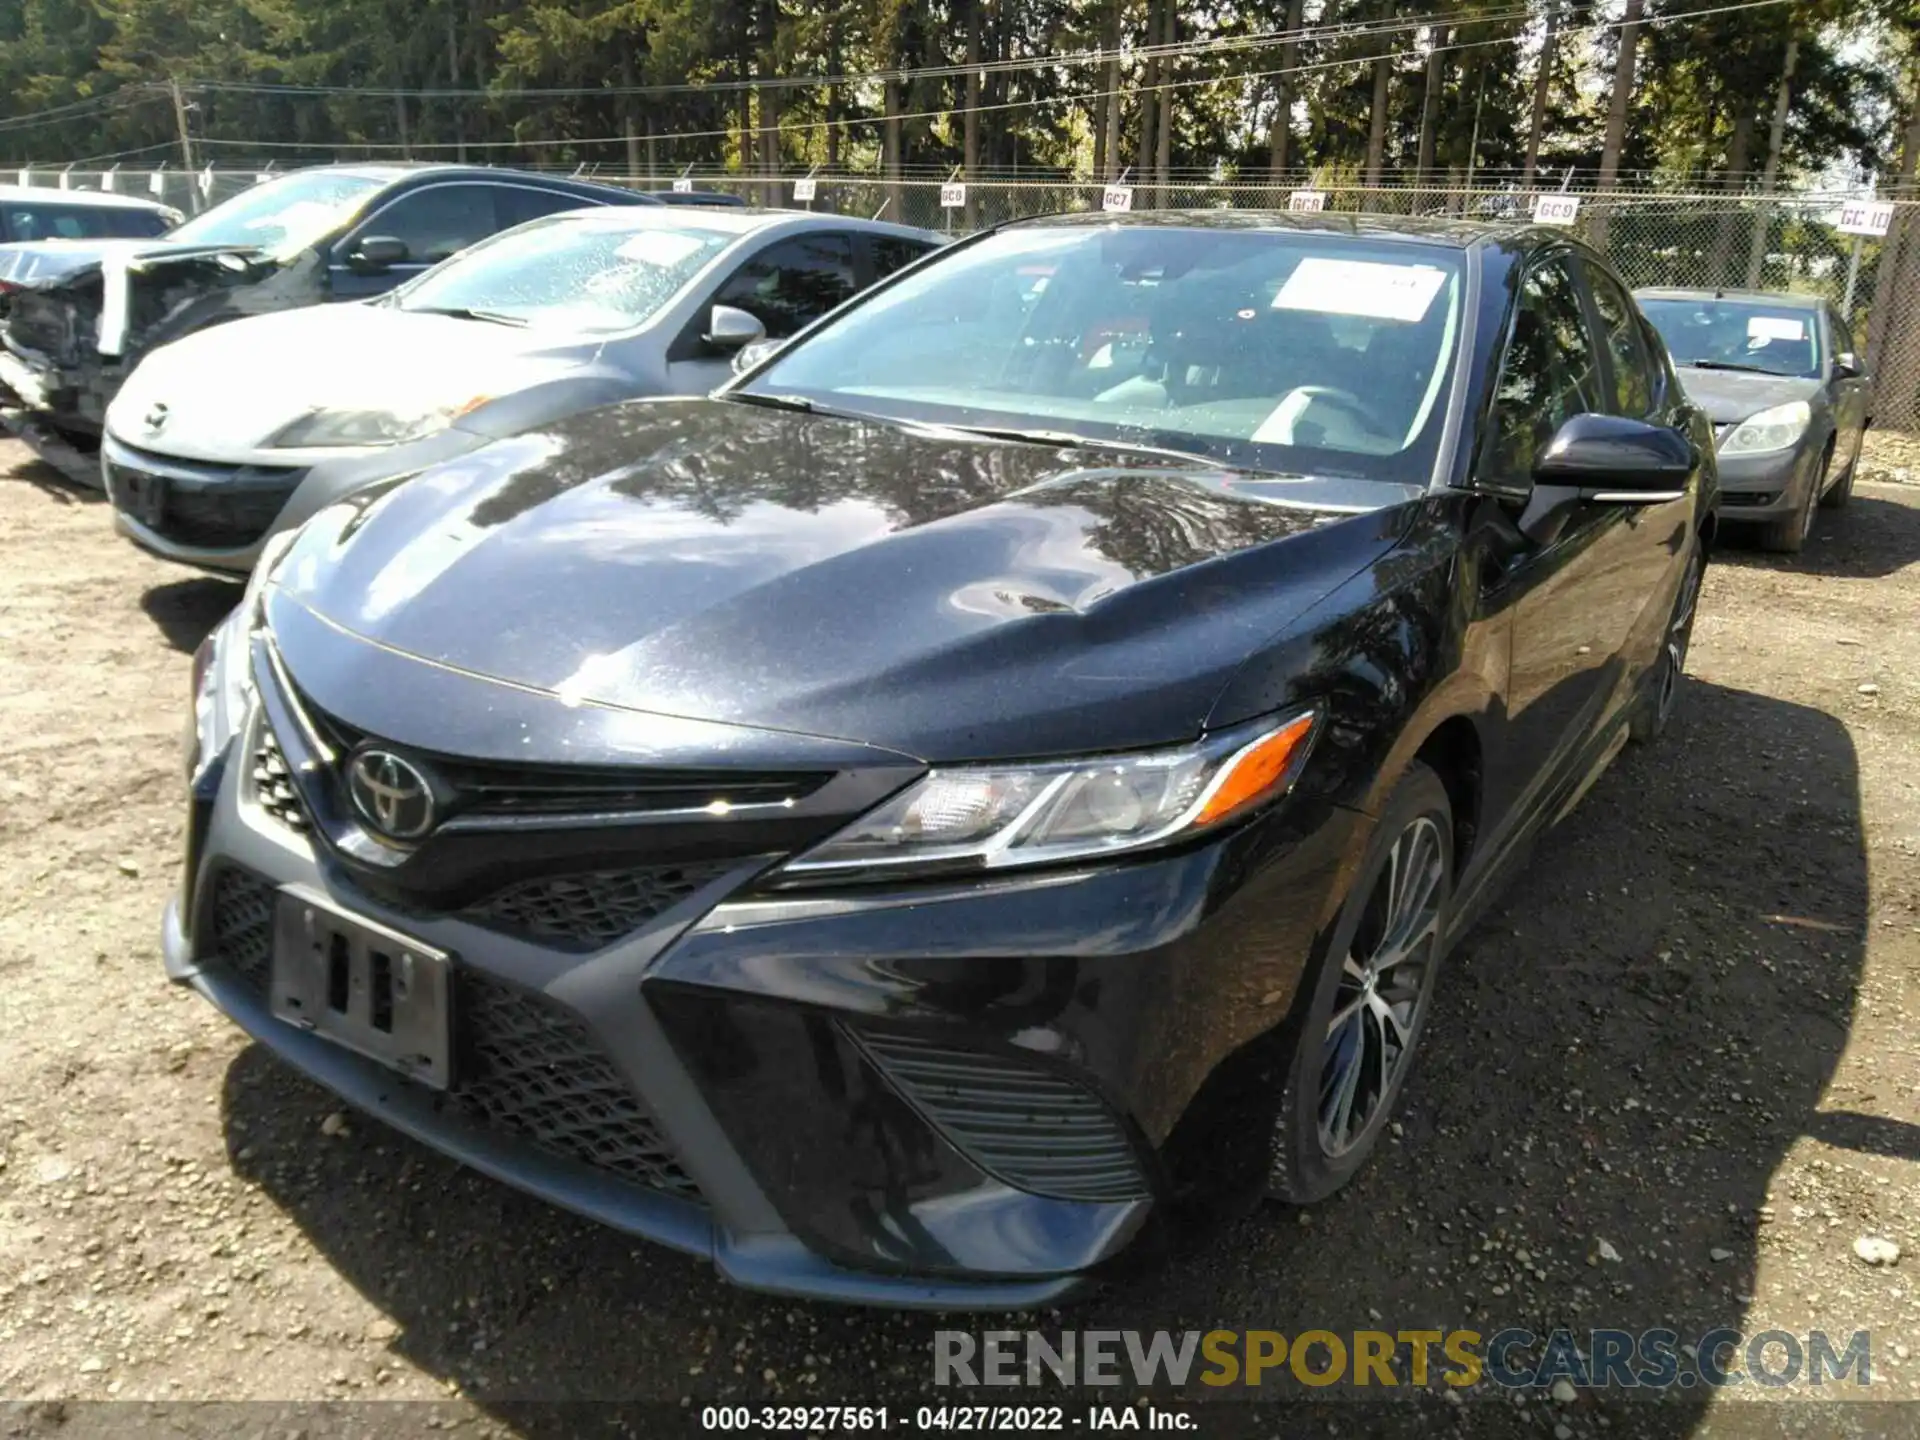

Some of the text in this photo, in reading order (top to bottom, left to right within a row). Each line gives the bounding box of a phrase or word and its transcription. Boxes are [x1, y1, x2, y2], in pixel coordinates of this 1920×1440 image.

[1105, 192, 1128, 206] GC7
[1540, 202, 1573, 218] GC9
[1840, 209, 1866, 226] GC
